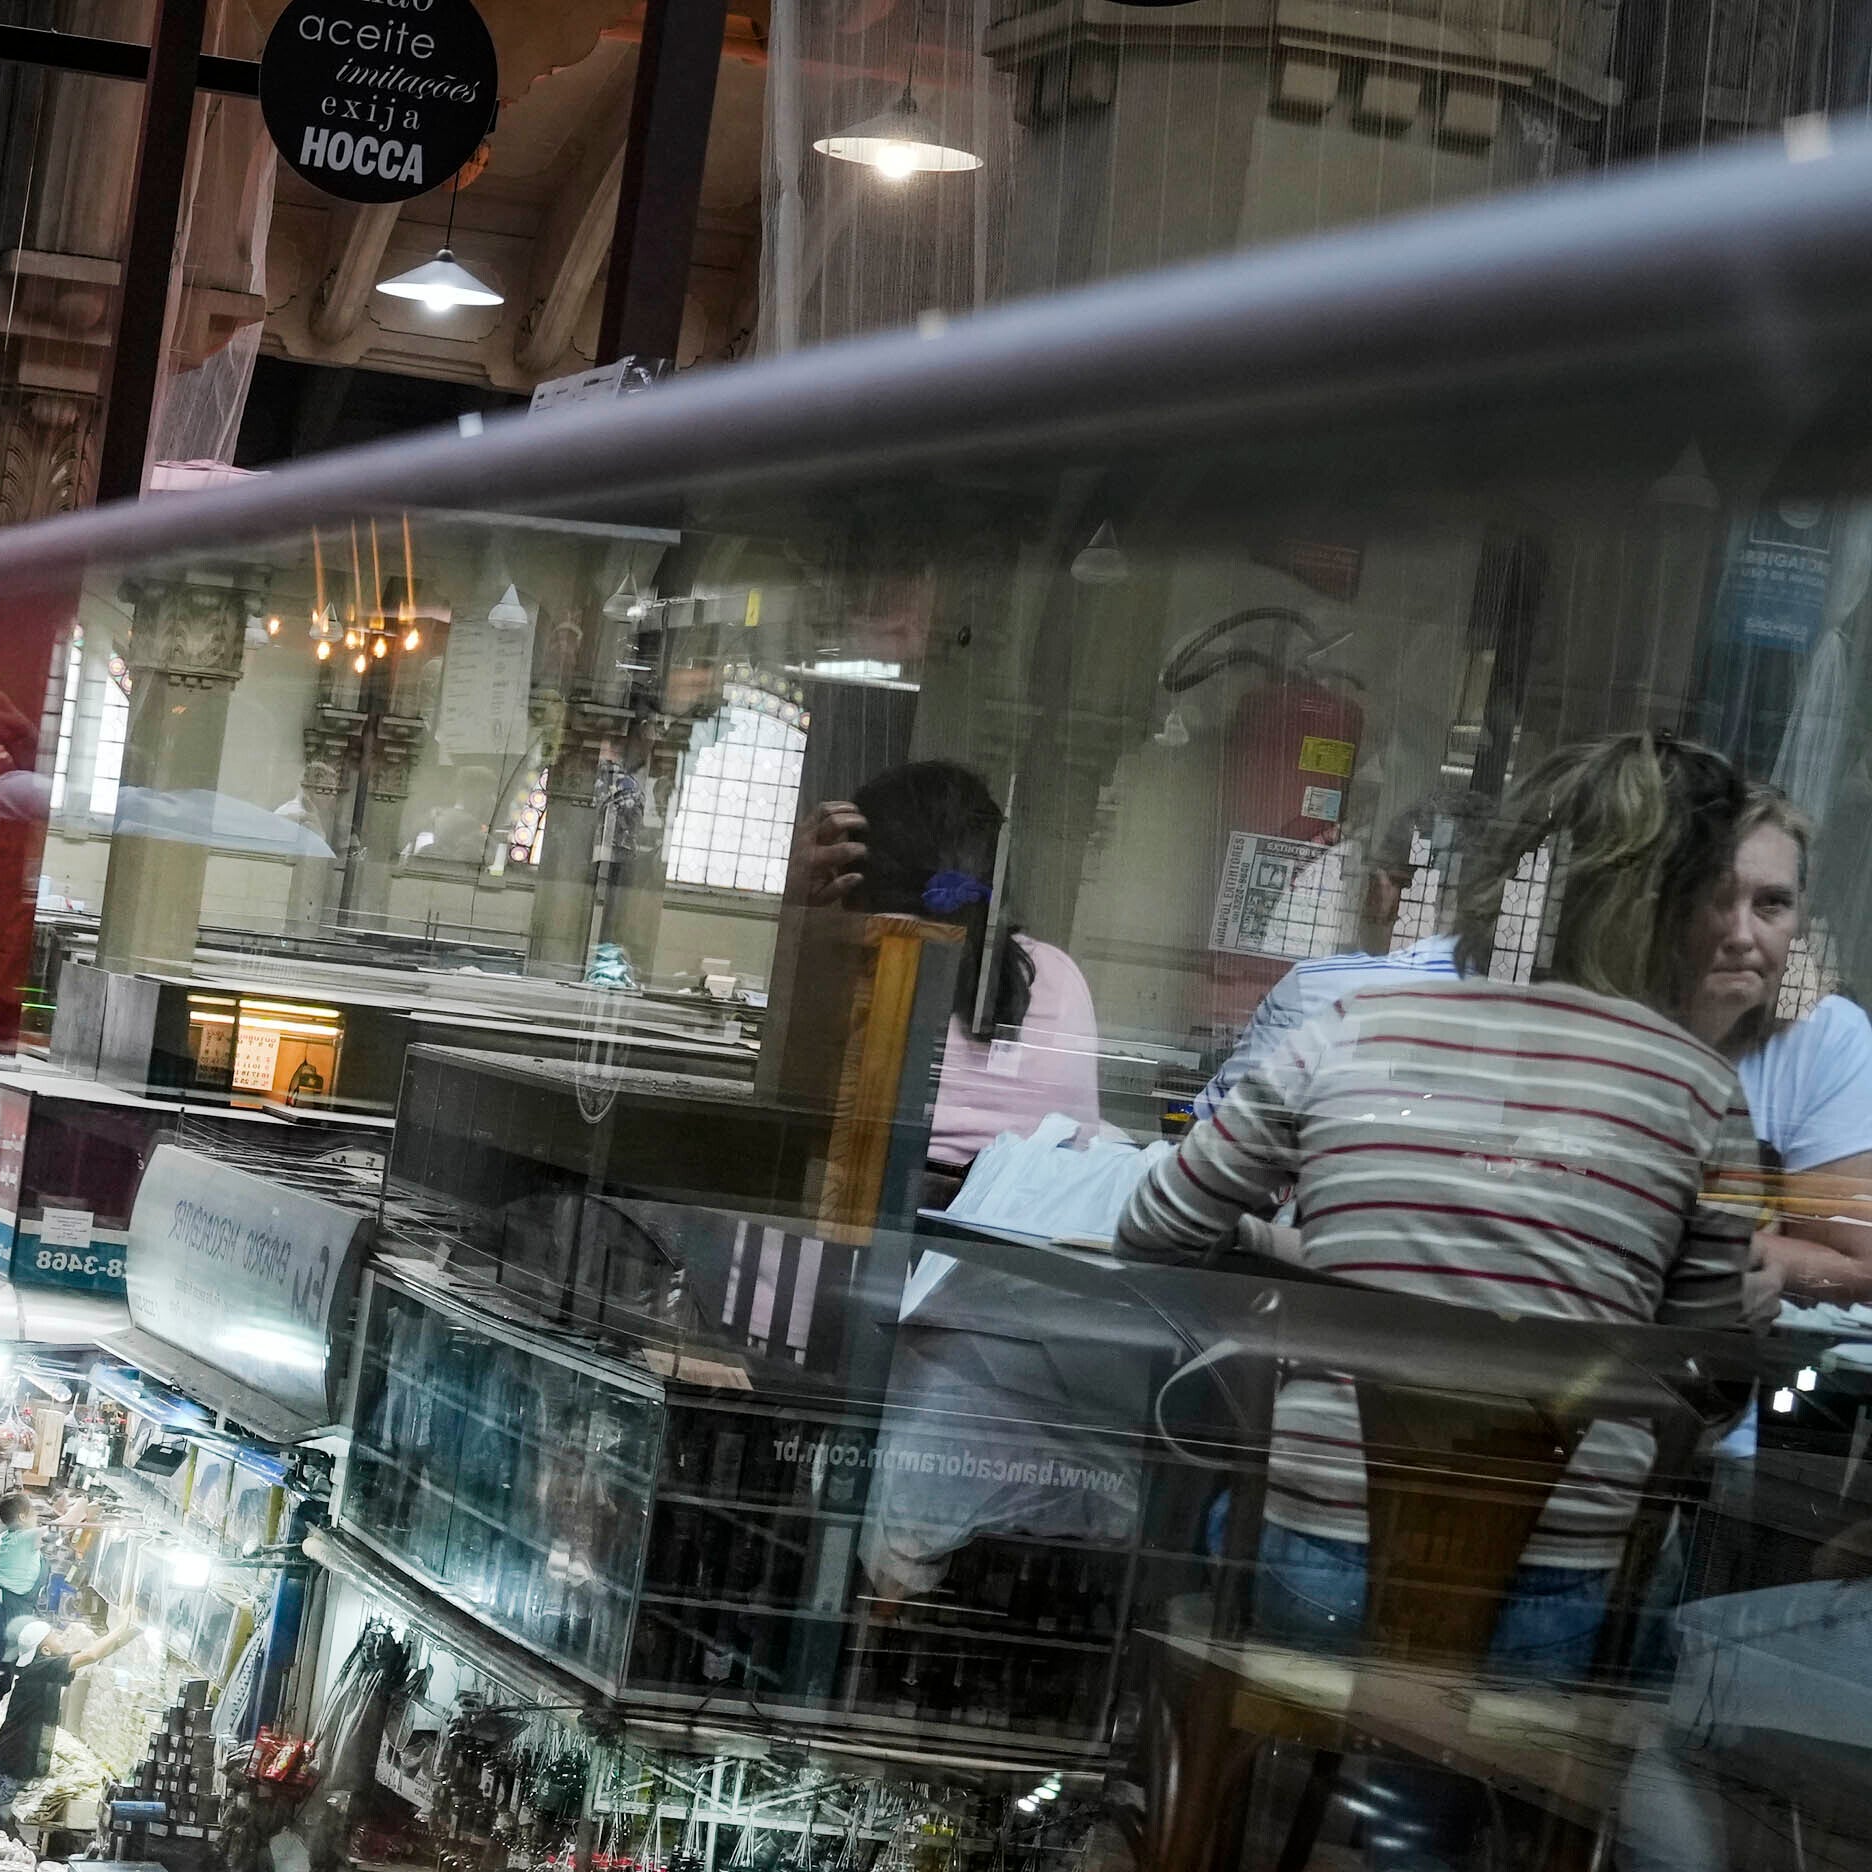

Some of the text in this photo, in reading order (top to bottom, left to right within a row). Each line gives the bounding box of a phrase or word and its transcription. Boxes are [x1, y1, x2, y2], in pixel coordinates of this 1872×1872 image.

[299, 14, 435, 59] aceite
[336, 57, 480, 104] imitações
[321, 96, 421, 132] exija
[299, 126, 424, 185] HOCCA
